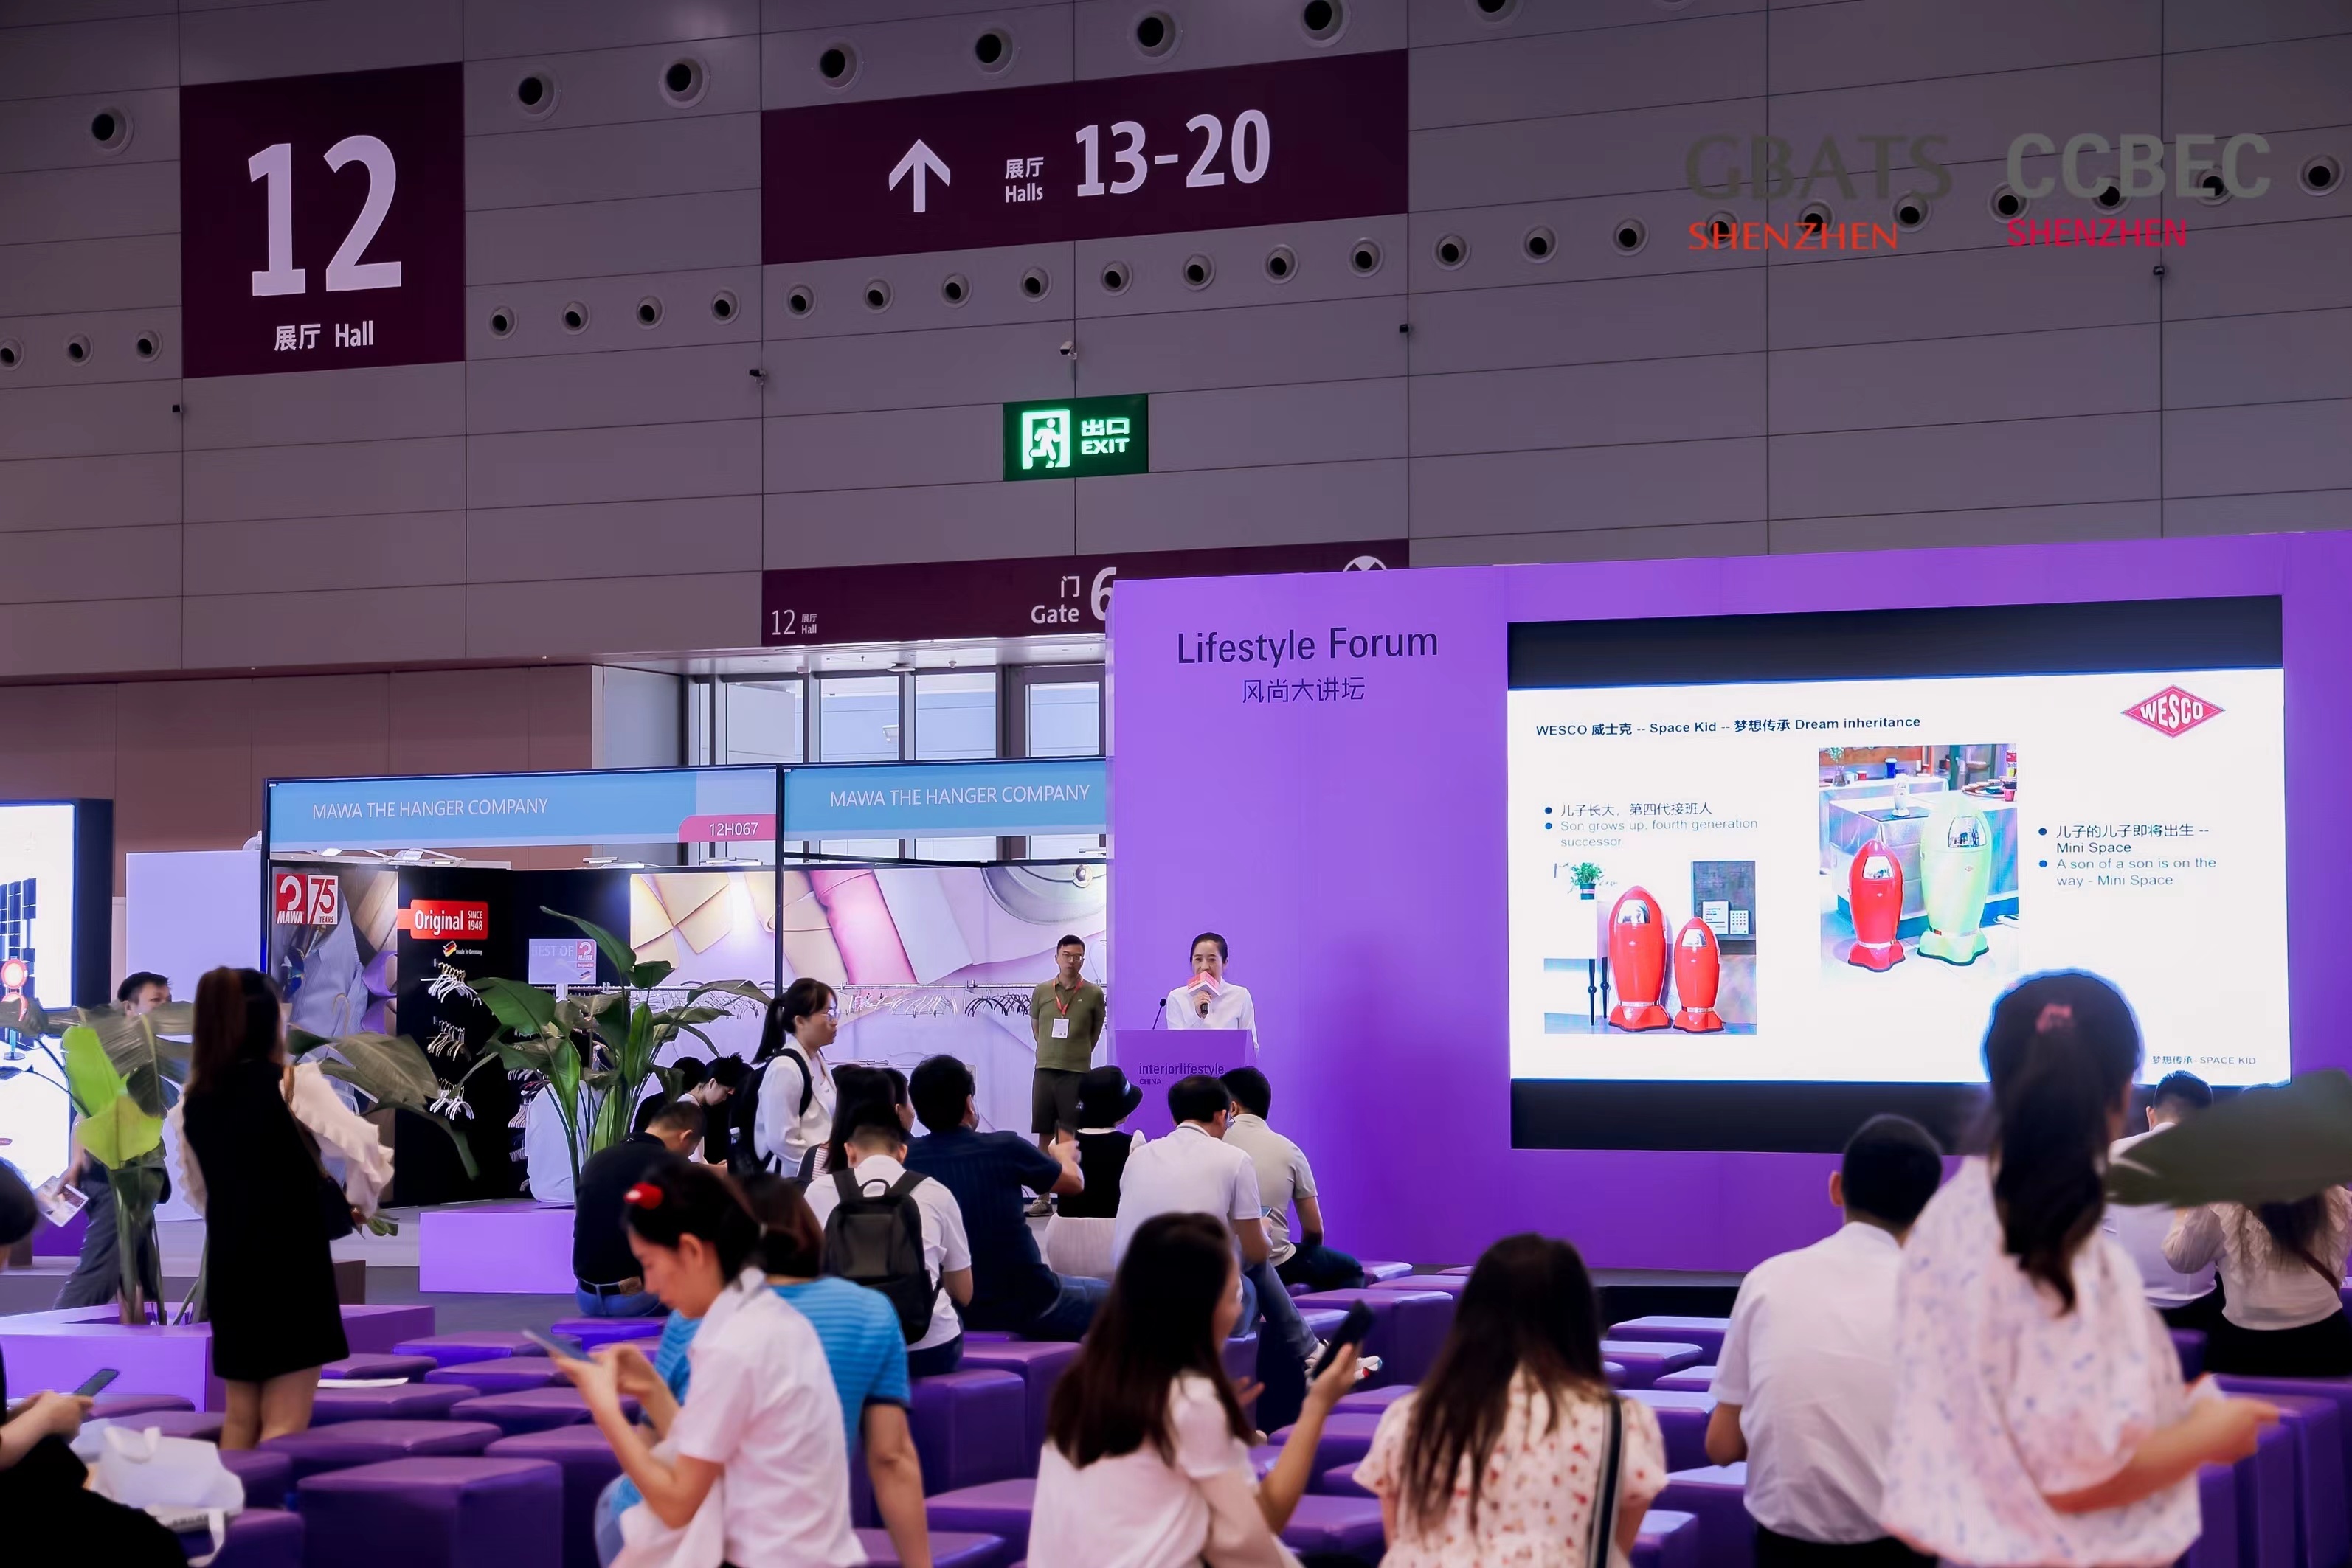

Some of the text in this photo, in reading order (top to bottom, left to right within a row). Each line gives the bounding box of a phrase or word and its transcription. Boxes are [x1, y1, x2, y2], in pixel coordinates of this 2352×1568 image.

[1075, 108, 1271, 198] 13-20
[1004, 156, 1045, 180] 展厅
[1005, 183, 1044, 204] Halls
[248, 134, 401, 296] 12
[274, 320, 374, 352] 展厅 Hall
[1080, 417, 1130, 437] 出口
[1080, 437, 1130, 456] EXIT
[1060, 575, 1080, 599] 门
[1090, 566, 1117, 622] 6
[771, 609, 796, 636] 12
[801, 613, 818, 623] 展厅
[1030, 604, 1080, 625] Gate
[801, 624, 817, 635] Hall
[1177, 626, 1439, 669] Lifestyle Forum
[1242, 676, 1366, 704] 风尚大讲坛
[2139, 693, 2204, 729] WESCO
[1536, 725, 1588, 736] WESCO
[1591, 722, 1633, 736] 威士克
[1649, 722, 1690, 735] Space
[1695, 721, 1718, 732] Kid
[1734, 718, 1791, 732] 梦想传承
[1795, 718, 1839, 730] Dream
[1844, 716, 1921, 729] inheritance
[830, 783, 1090, 808] MAWA THE HANGER COMPANY
[312, 797, 549, 819] MAWA THE HANGER COMPANY
[708, 822, 759, 836] 12H067
[1560, 820, 1585, 831] Son
[1588, 822, 1625, 833] grows
[1652, 819, 1687, 830] fourth
[1691, 819, 1759, 831] generation
[2056, 823, 2195, 839] 儿子的儿子即将出生
[1560, 837, 1622, 847] successor
[2057, 842, 2132, 855] Mini Space
[2056, 857, 2217, 870] A son of a son is on the
[2057, 878, 2084, 889] way
[2097, 875, 2126, 887] Mini
[2130, 875, 2173, 888] Space
[311, 878, 336, 925] 75
[276, 910, 304, 925] MAWA
[319, 915, 334, 923] YEARS
[414, 909, 463, 936] Original
[467, 909, 483, 920] SINCE
[467, 920, 483, 932] 1948
[1138, 1062, 1225, 1077] interiorlifestyle
[2199, 1056, 2235, 1064] SPACE
[2238, 1056, 2256, 1064] KID
